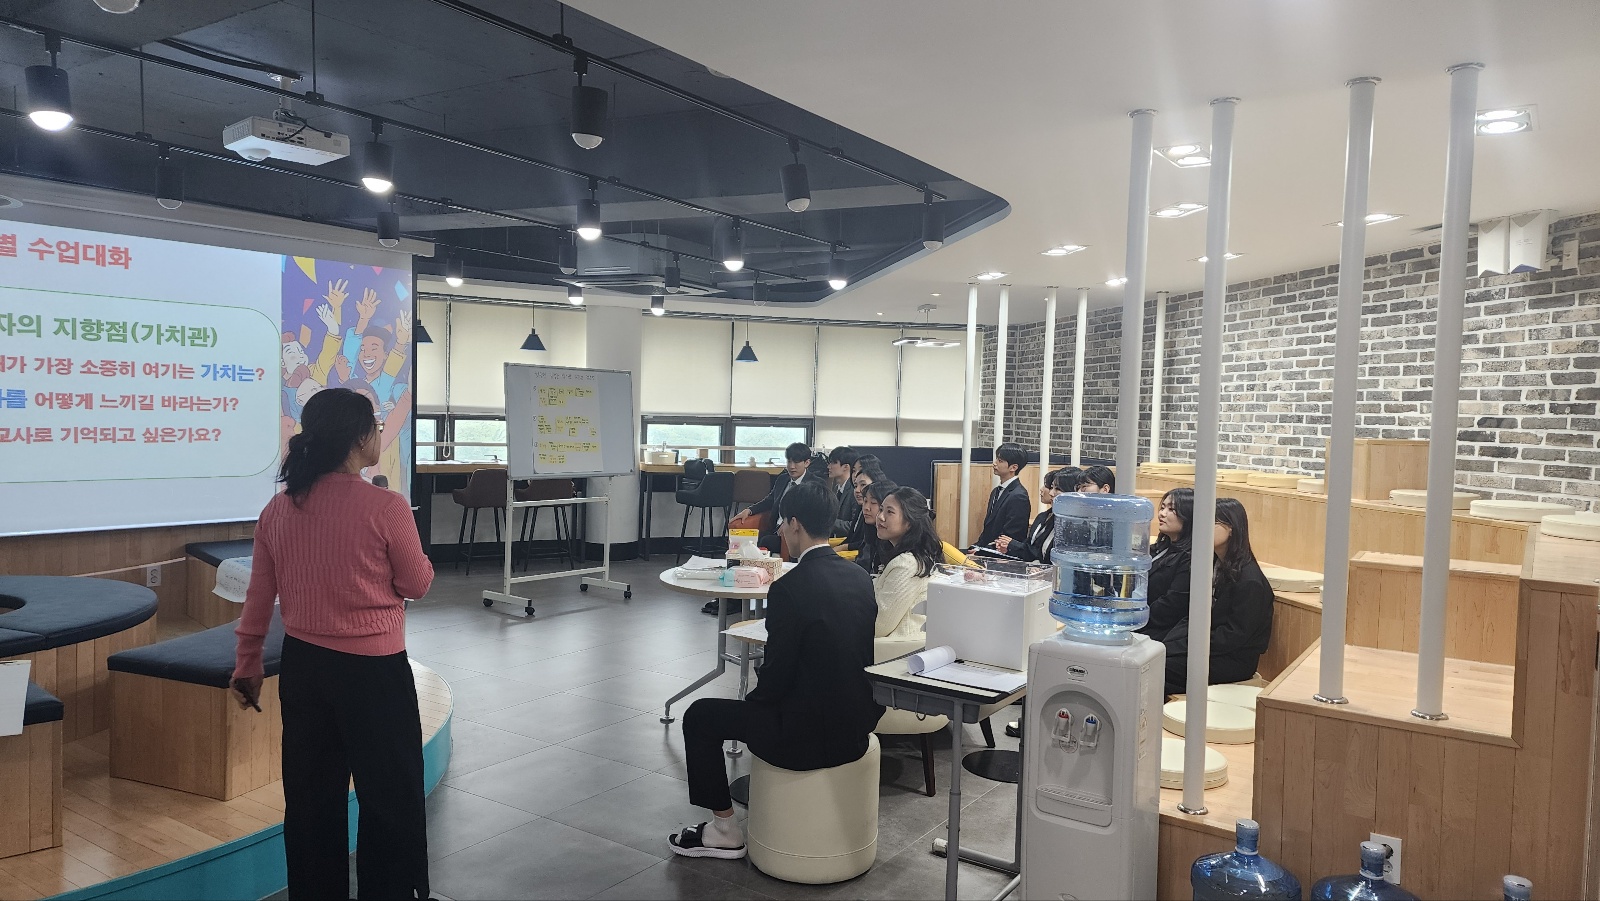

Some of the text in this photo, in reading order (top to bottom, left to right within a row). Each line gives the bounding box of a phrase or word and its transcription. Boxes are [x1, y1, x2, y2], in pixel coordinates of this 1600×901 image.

[27, 238, 132, 269] 수업대화
[53, 317, 218, 348] 지향점(가치관)
[0, 355, 265, 382] 가 가장 소중히 여기는 가치는?
[0, 389, 239, 412] 를 어떻게 느끼길 바라는가?
[0, 427, 222, 444] 교사로 기억되고 싶은가요?
